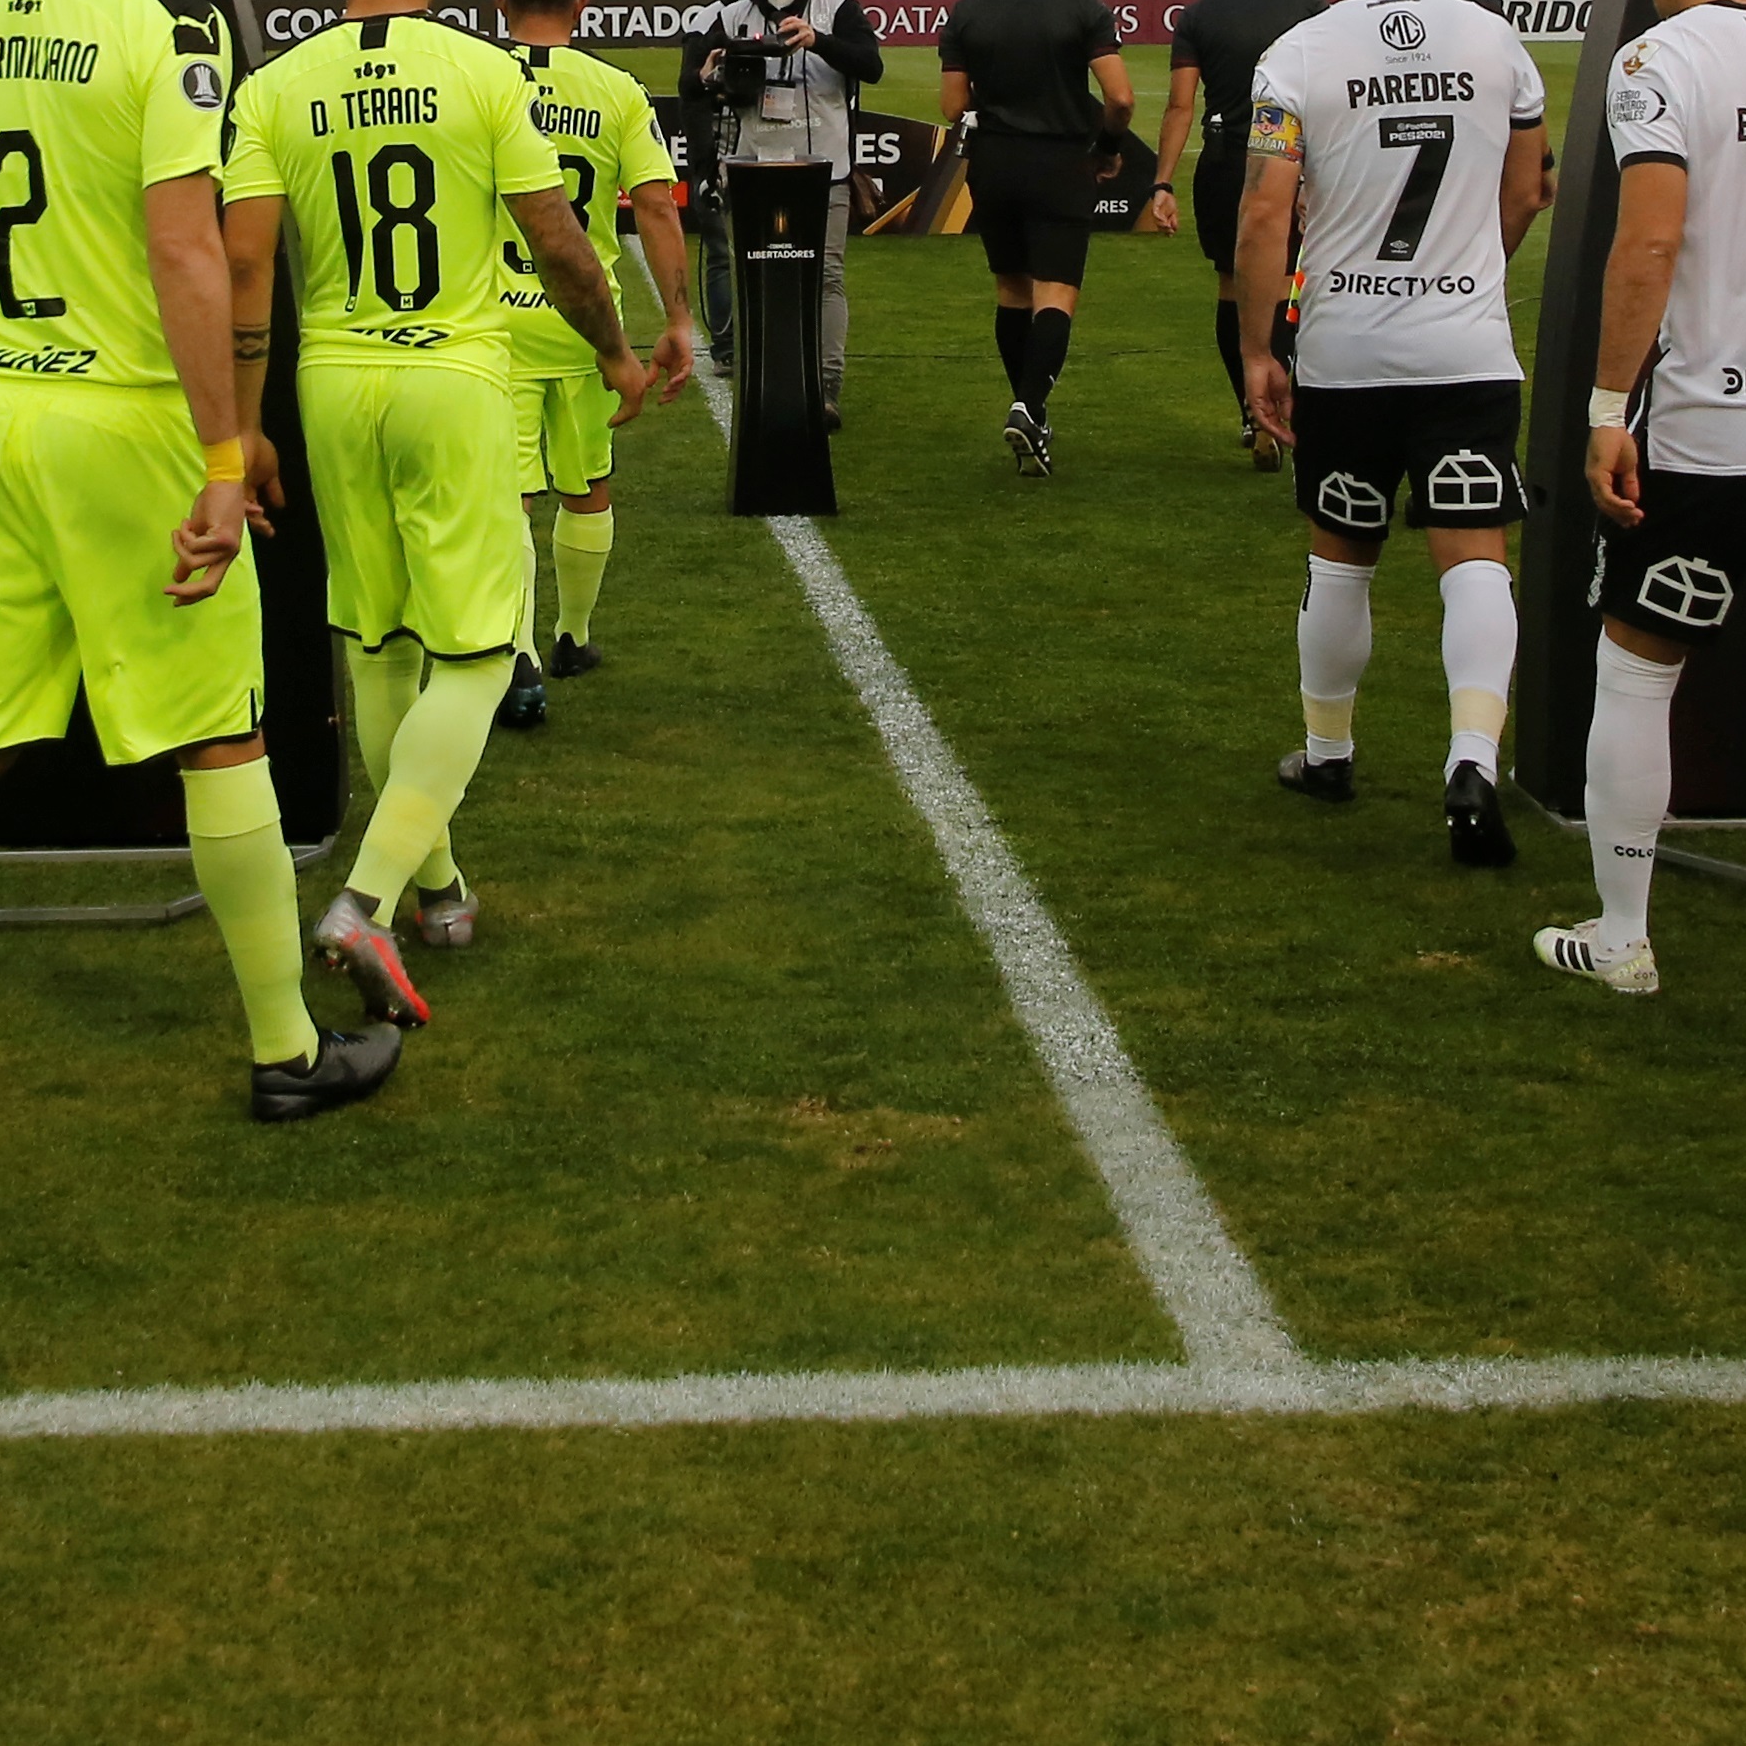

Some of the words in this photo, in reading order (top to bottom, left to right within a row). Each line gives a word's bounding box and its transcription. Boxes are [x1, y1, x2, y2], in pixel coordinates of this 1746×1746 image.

[310, 100, 335, 137] D.
[341, 86, 437, 130] TERANS
[1347, 71, 1475, 110] PAREDES
[1376, 115, 1455, 261] 7
[331, 143, 441, 312] 18
[747, 249, 815, 260] LIBERTADORES
[1437, 275, 1475, 295] GO
